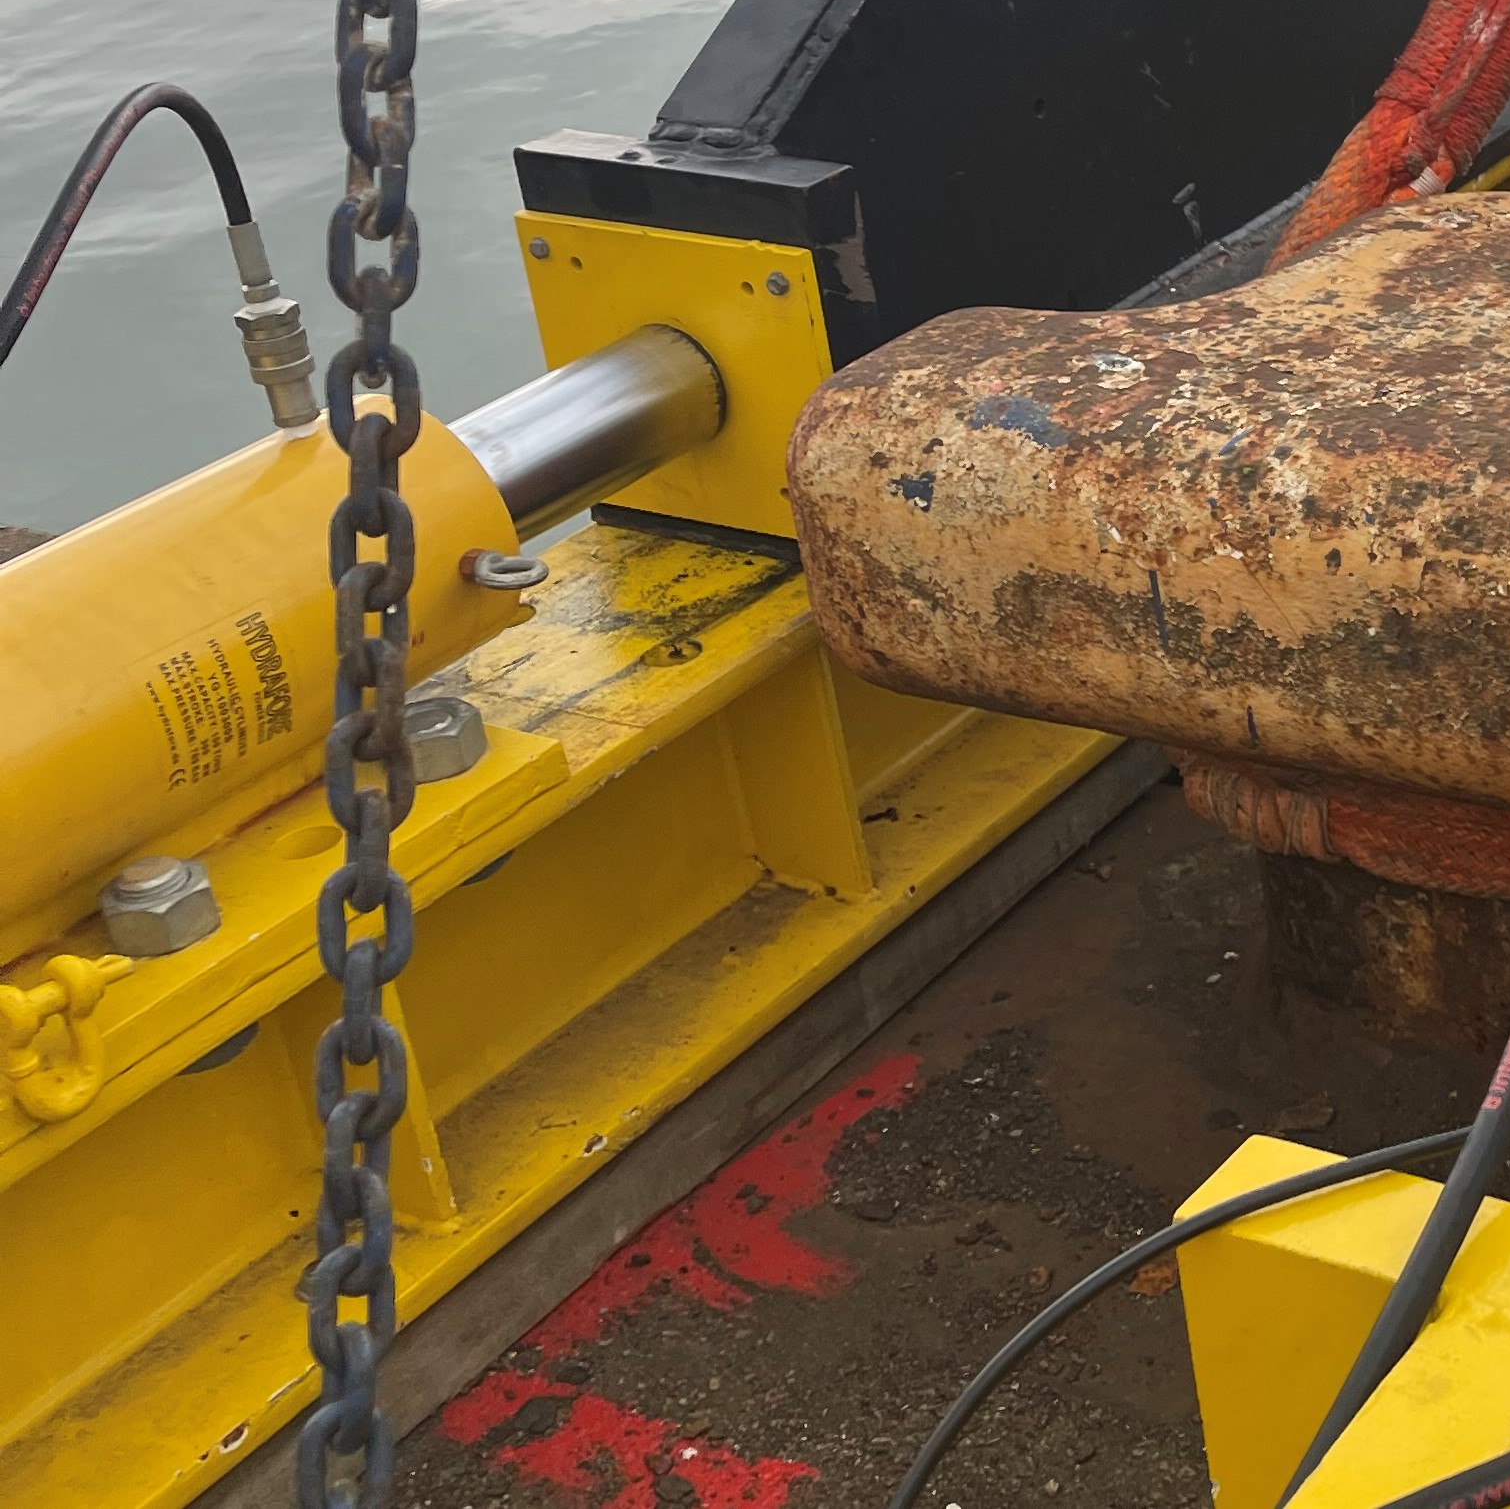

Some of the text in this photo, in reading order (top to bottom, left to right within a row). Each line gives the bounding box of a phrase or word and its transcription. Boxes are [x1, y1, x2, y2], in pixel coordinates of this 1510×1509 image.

[159, 662, 175, 685] MAX
[170, 657, 187, 680] MAX
[181, 651, 198, 673] MAX
[207, 638, 241, 704] HYDRAULIC
